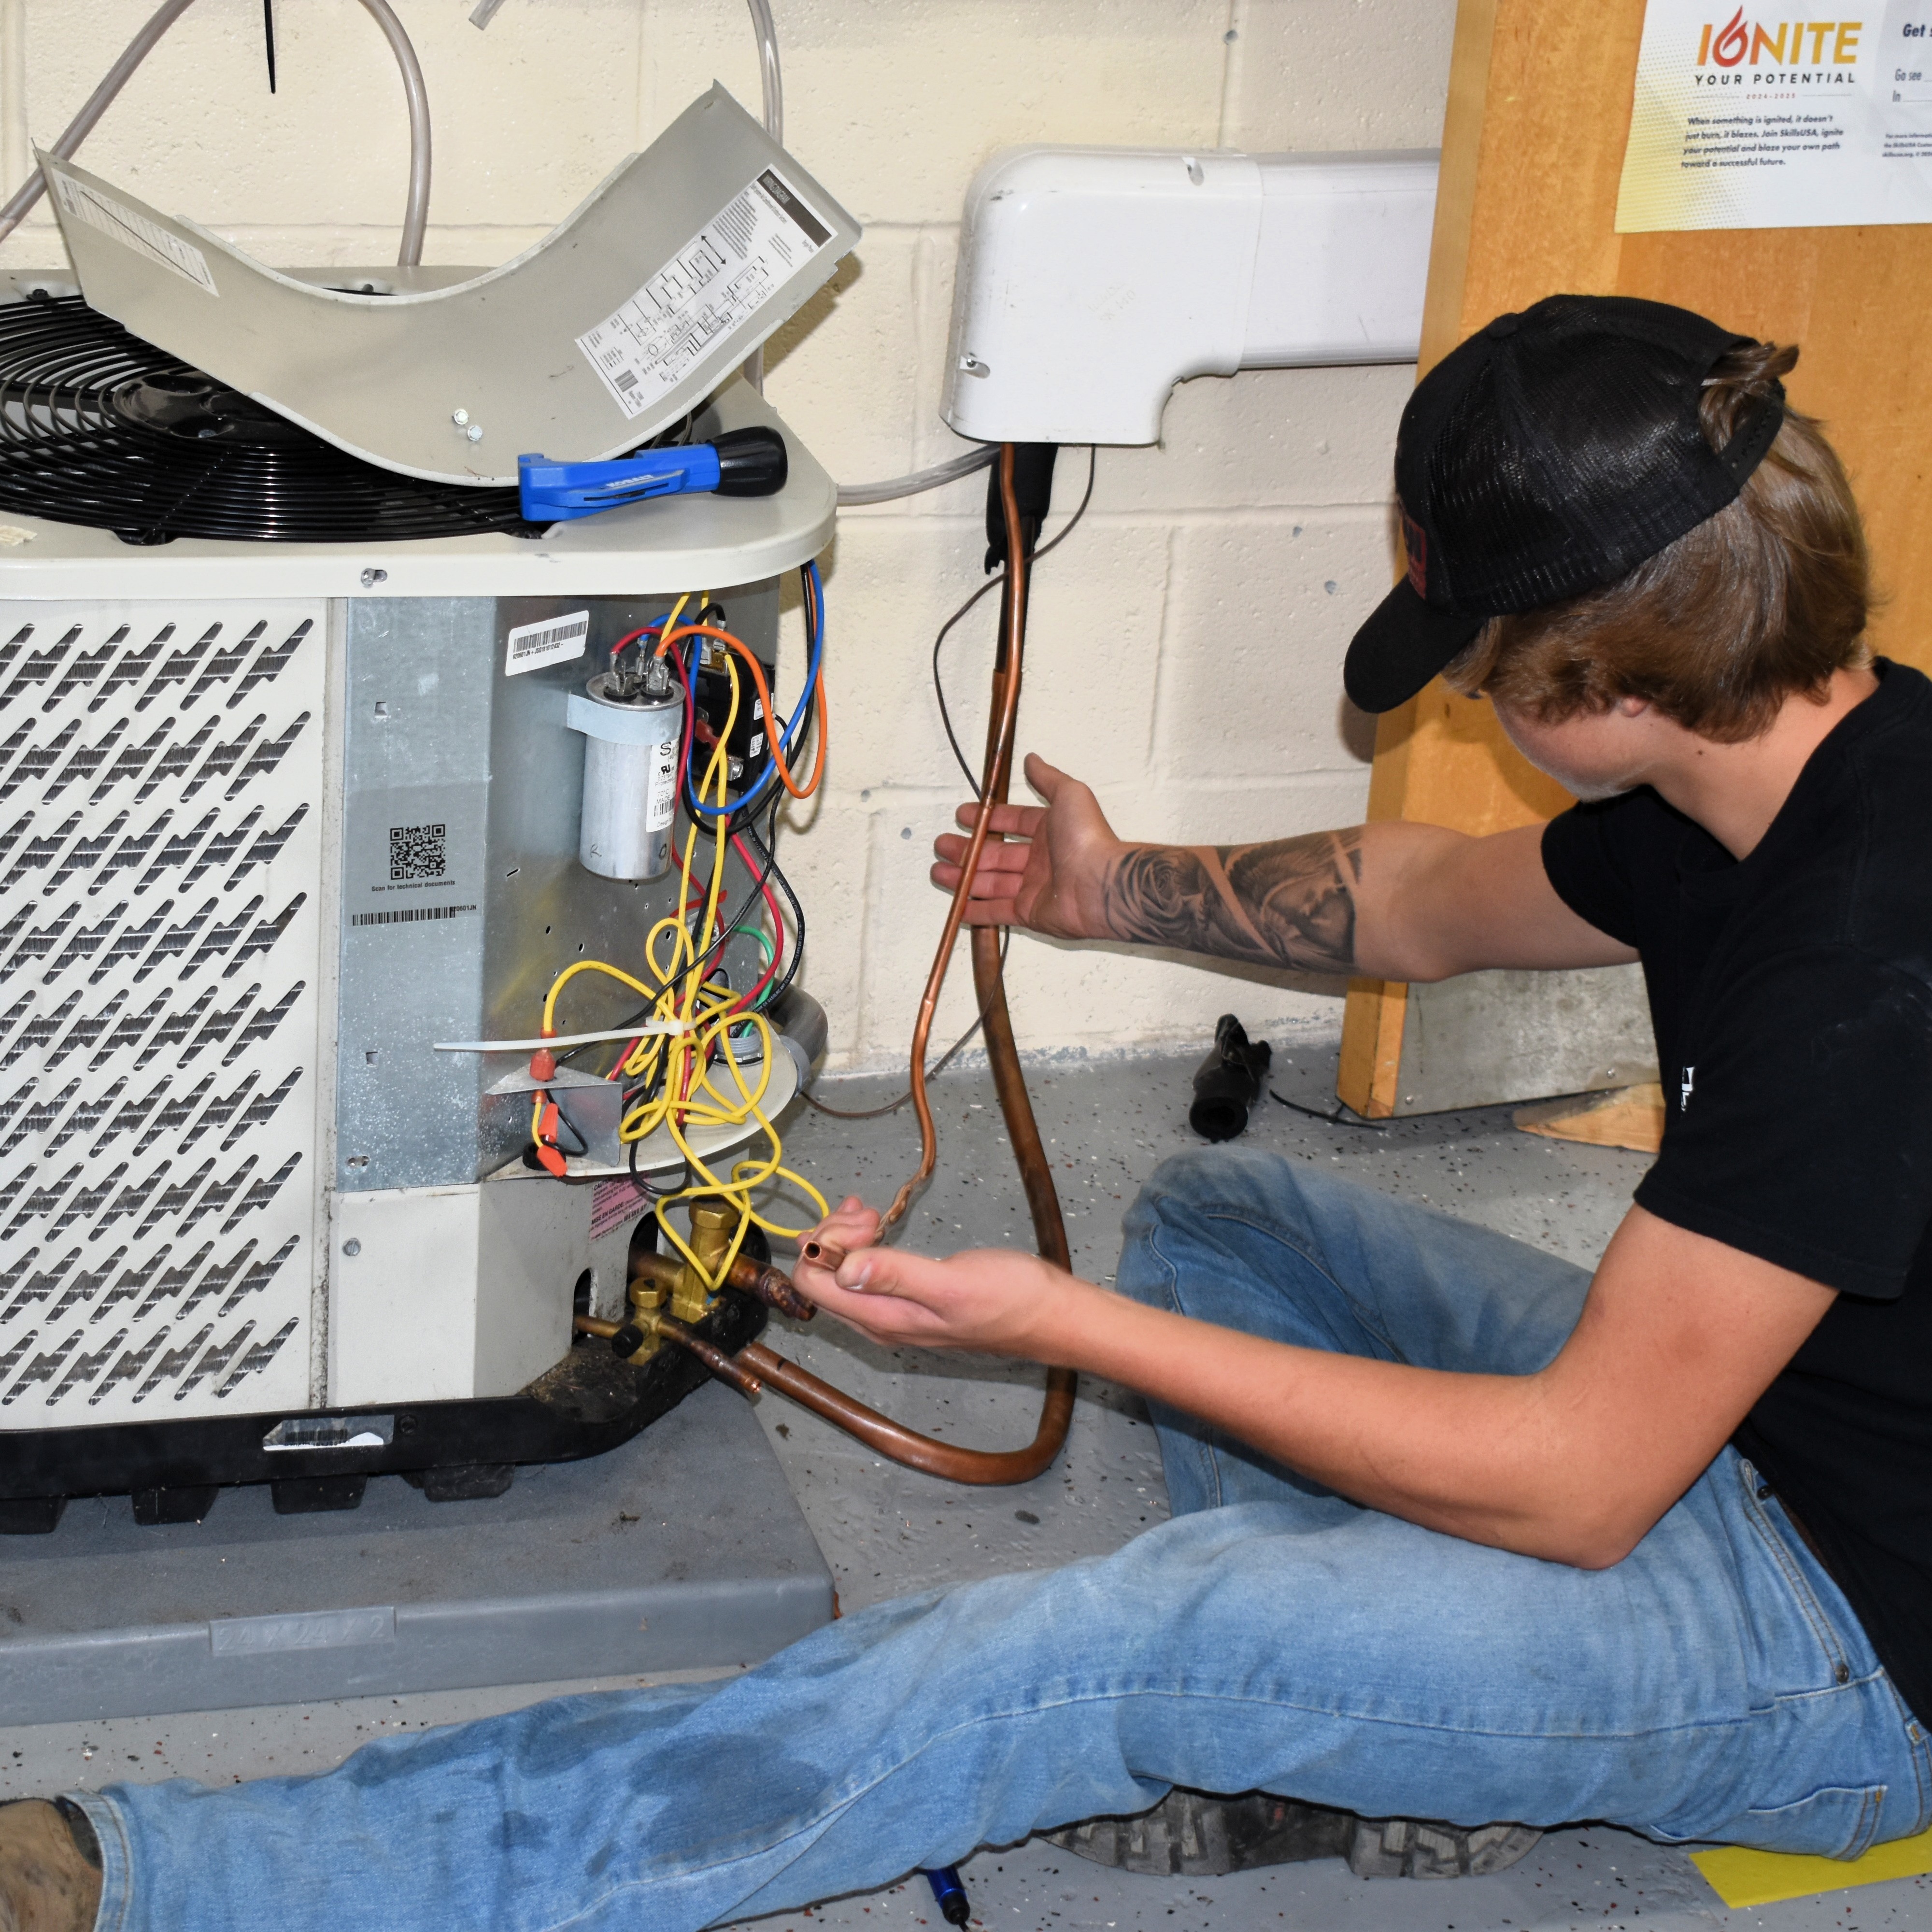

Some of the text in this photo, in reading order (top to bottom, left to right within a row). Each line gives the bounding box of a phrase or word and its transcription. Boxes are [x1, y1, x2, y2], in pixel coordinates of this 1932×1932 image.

[1697, 5, 1862, 67] IGNITE
[1903, 23, 1925, 37] Get
[1695, 73, 1856, 85] YOUR POTENTIAL
[1895, 69, 1922, 81] Go see
[1892, 90, 1901, 102] In
[1712, 116, 1754, 125] something
[1763, 115, 1793, 125] ignited,
[1685, 132, 1700, 142] just
[1731, 130, 1759, 138] blazes.
[1780, 128, 1818, 137] SkillsUSA,
[1821, 128, 1844, 138] ignite
[1704, 144, 1740, 155] potential
[1741, 144, 1757, 152] and
[1821, 142, 1840, 152] path
[1681, 159, 1711, 168] toward
[1719, 157, 1758, 167] successful
[656, 795, 671, 804] MADE
[767, 988, 781, 1003] GASOLINE
[592, 1215, 602, 1224] MISE
[602, 1210, 608, 1219] EN
[368, 1614, 385, 1638] 2
